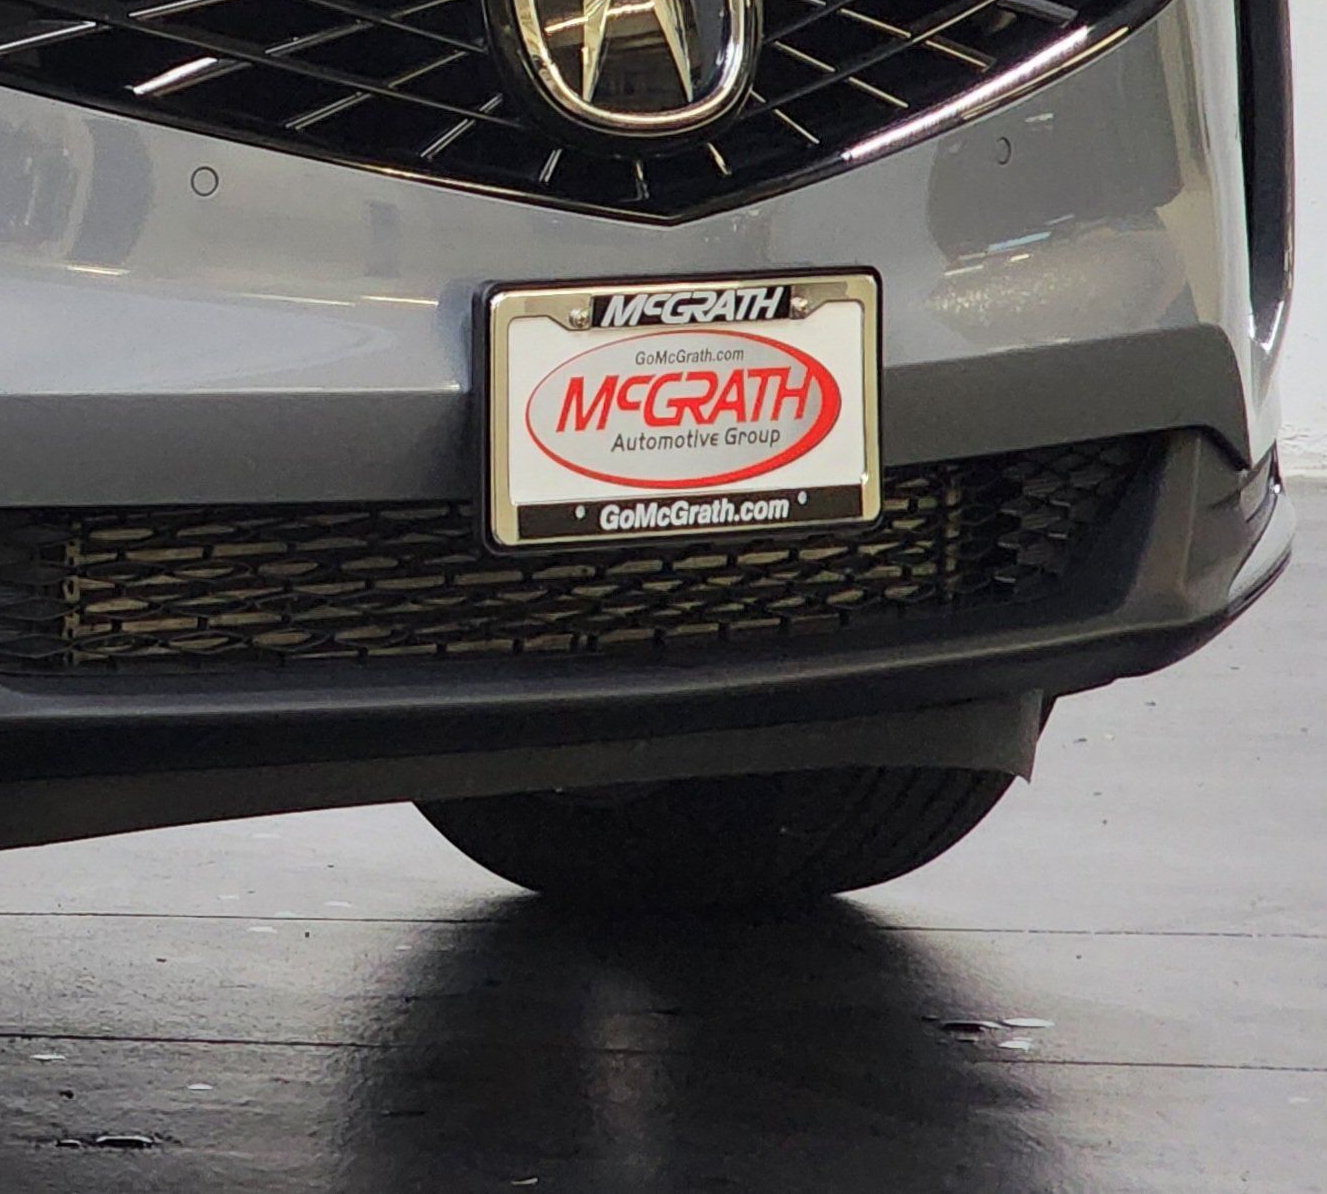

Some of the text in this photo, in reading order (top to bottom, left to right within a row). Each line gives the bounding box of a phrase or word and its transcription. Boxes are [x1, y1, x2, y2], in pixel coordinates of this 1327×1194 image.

[634, 348, 745, 367] GoMcGrath.com
[610, 427, 781, 453] Automotive Group
[598, 496, 790, 531] GoMcGrath.com
